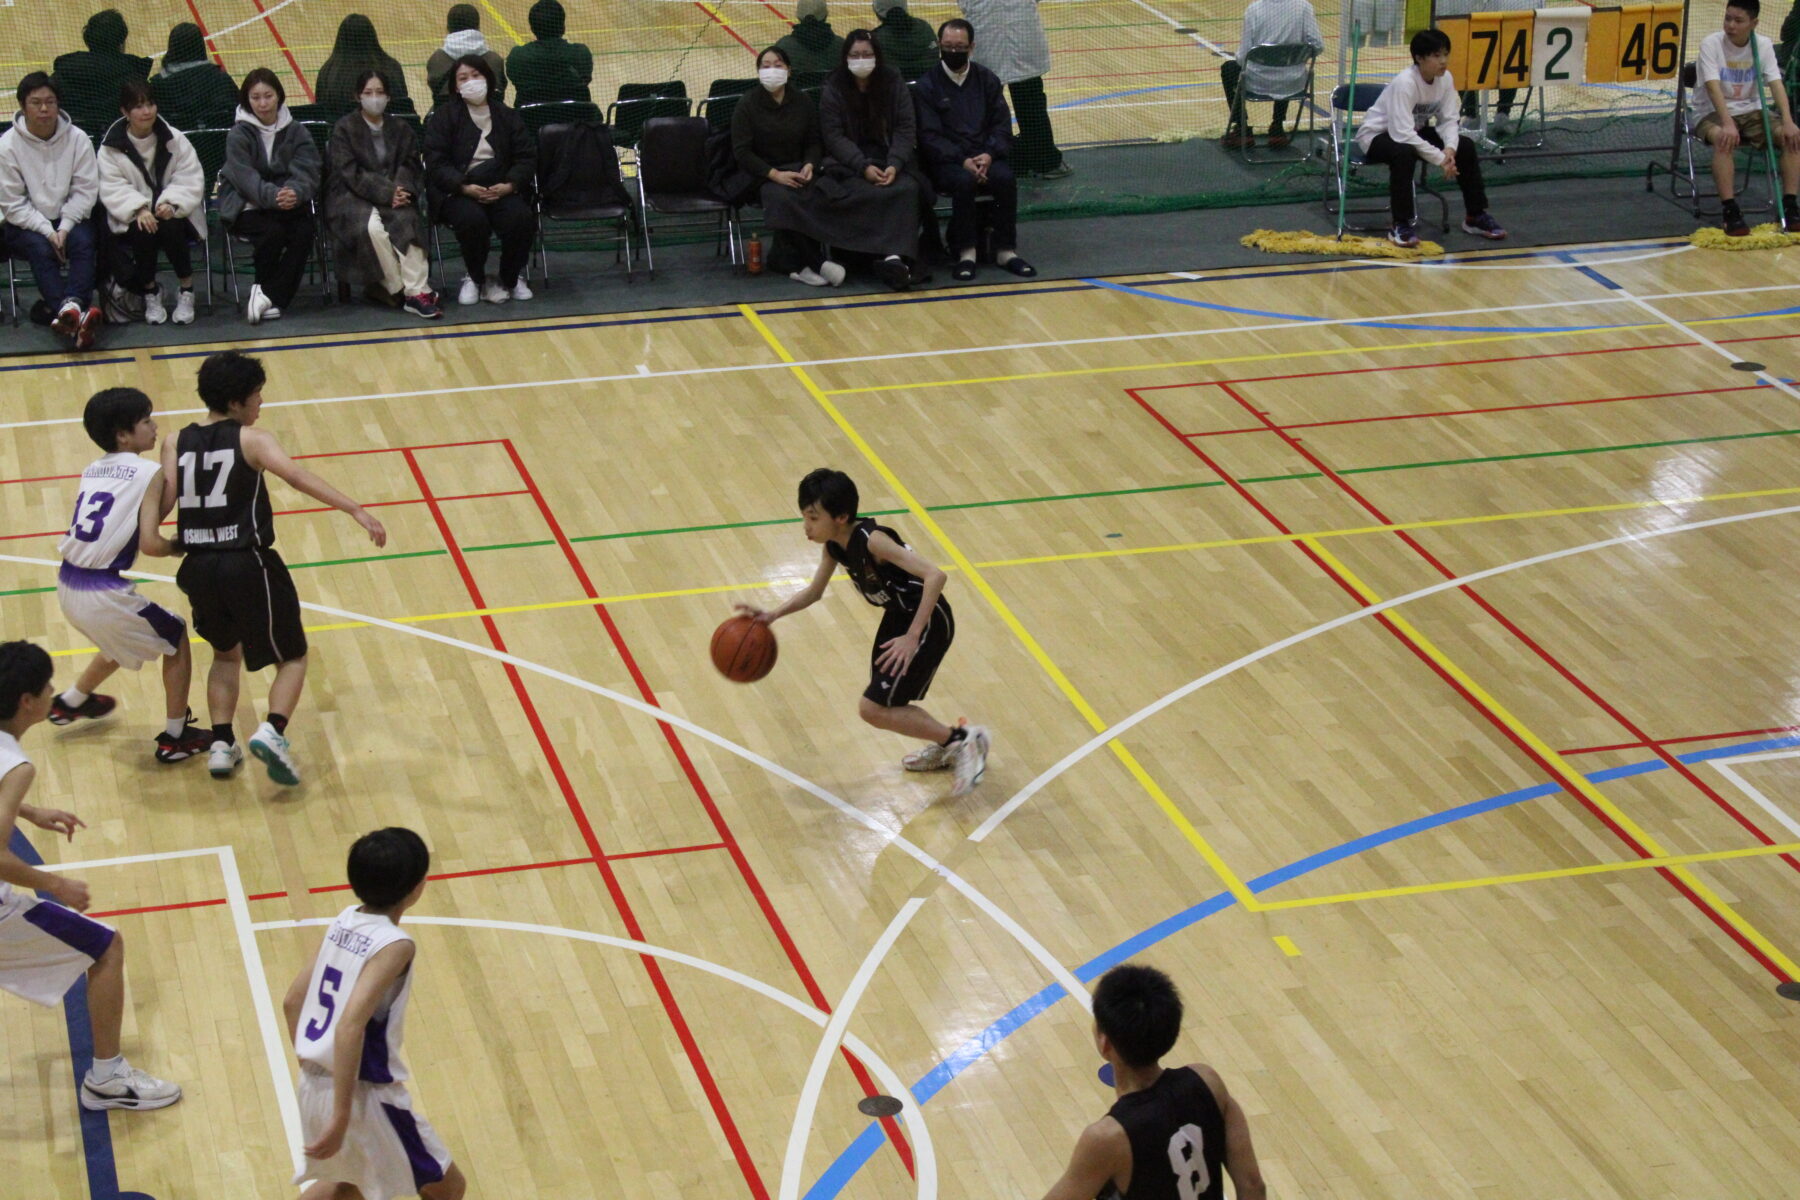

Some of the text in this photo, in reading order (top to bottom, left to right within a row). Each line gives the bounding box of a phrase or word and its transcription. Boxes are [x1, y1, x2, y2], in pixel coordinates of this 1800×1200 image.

[1471, 29, 1529, 84] 74
[1545, 27, 1573, 80] 2
[1621, 22, 1680, 75] 46
[178, 448, 235, 508] 17
[71, 491, 115, 543] 13
[216, 524, 239, 543] WEST
[305, 964, 343, 1042] 5
[1167, 1123, 1211, 1200] 8
